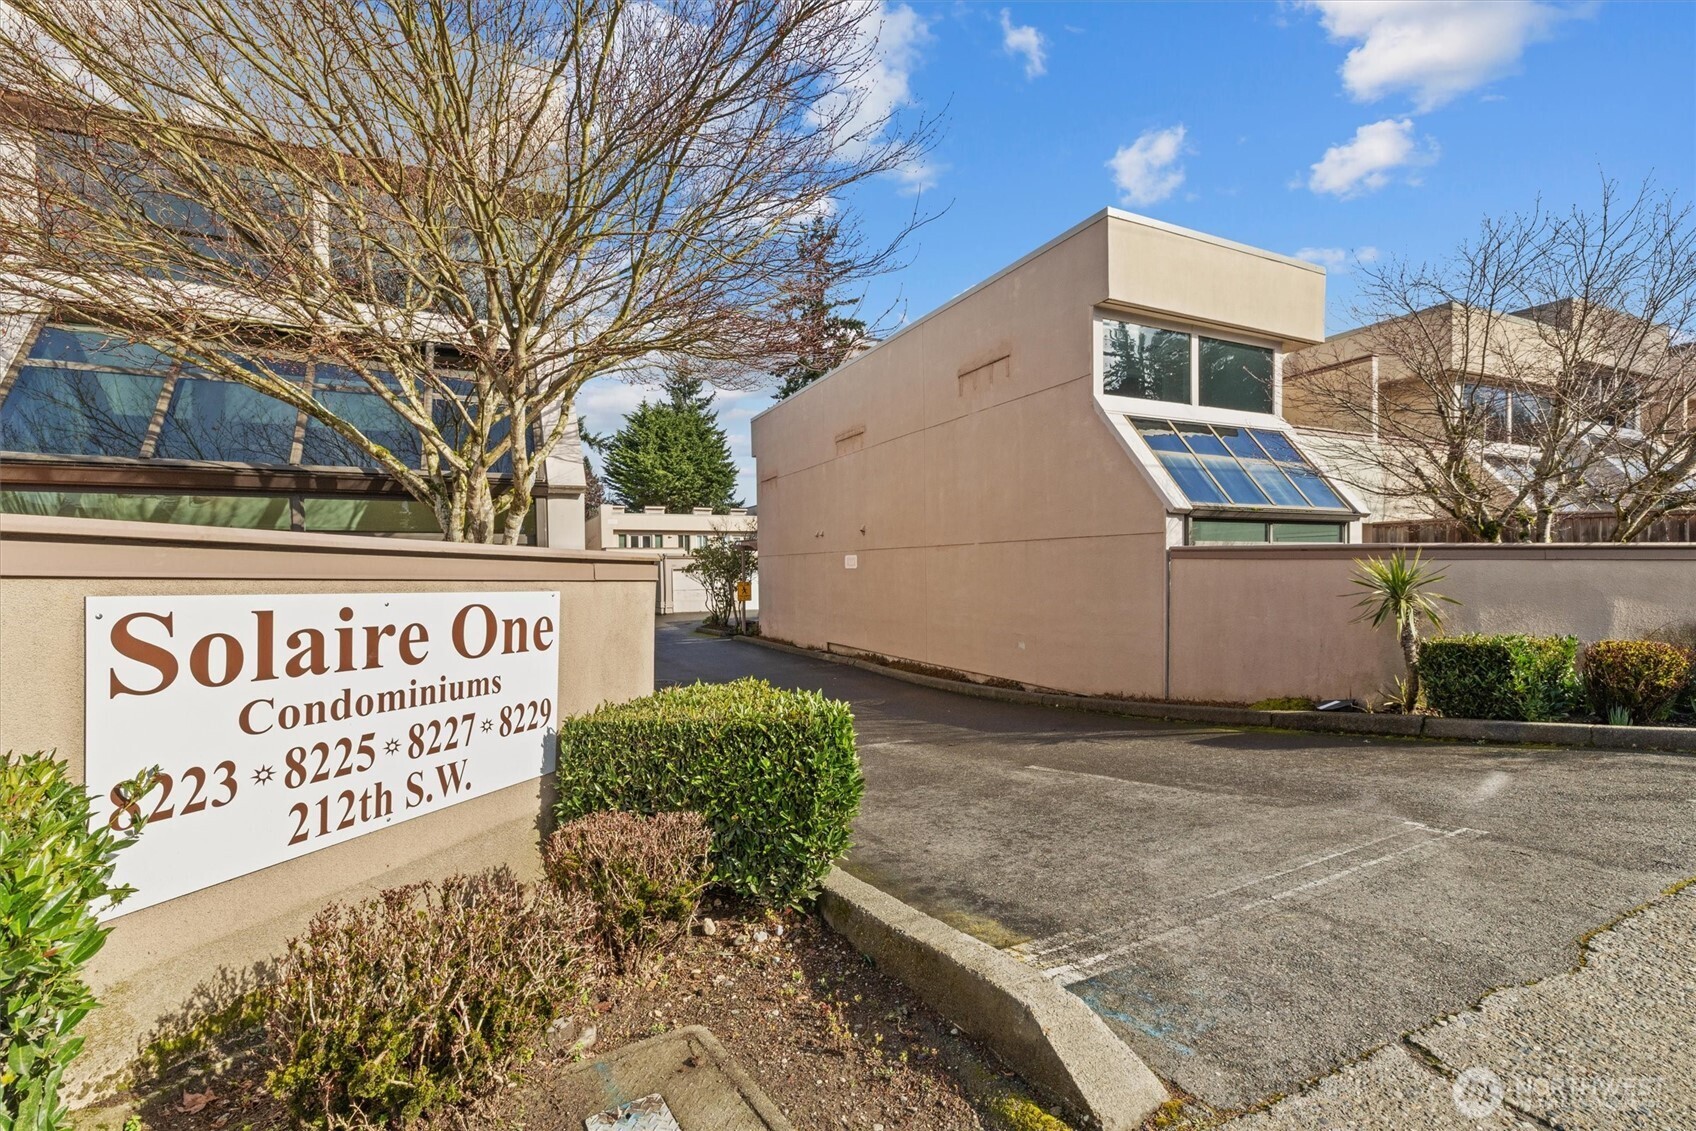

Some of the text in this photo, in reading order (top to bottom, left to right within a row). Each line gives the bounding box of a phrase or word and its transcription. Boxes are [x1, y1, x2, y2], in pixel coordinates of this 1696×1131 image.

[109, 603, 554, 700] Solaire One
[238, 675, 502, 735] Condominiums
[108, 697, 552, 832] 8223 8225 8227 8229
[287, 758, 472, 847] 212th S.W.
